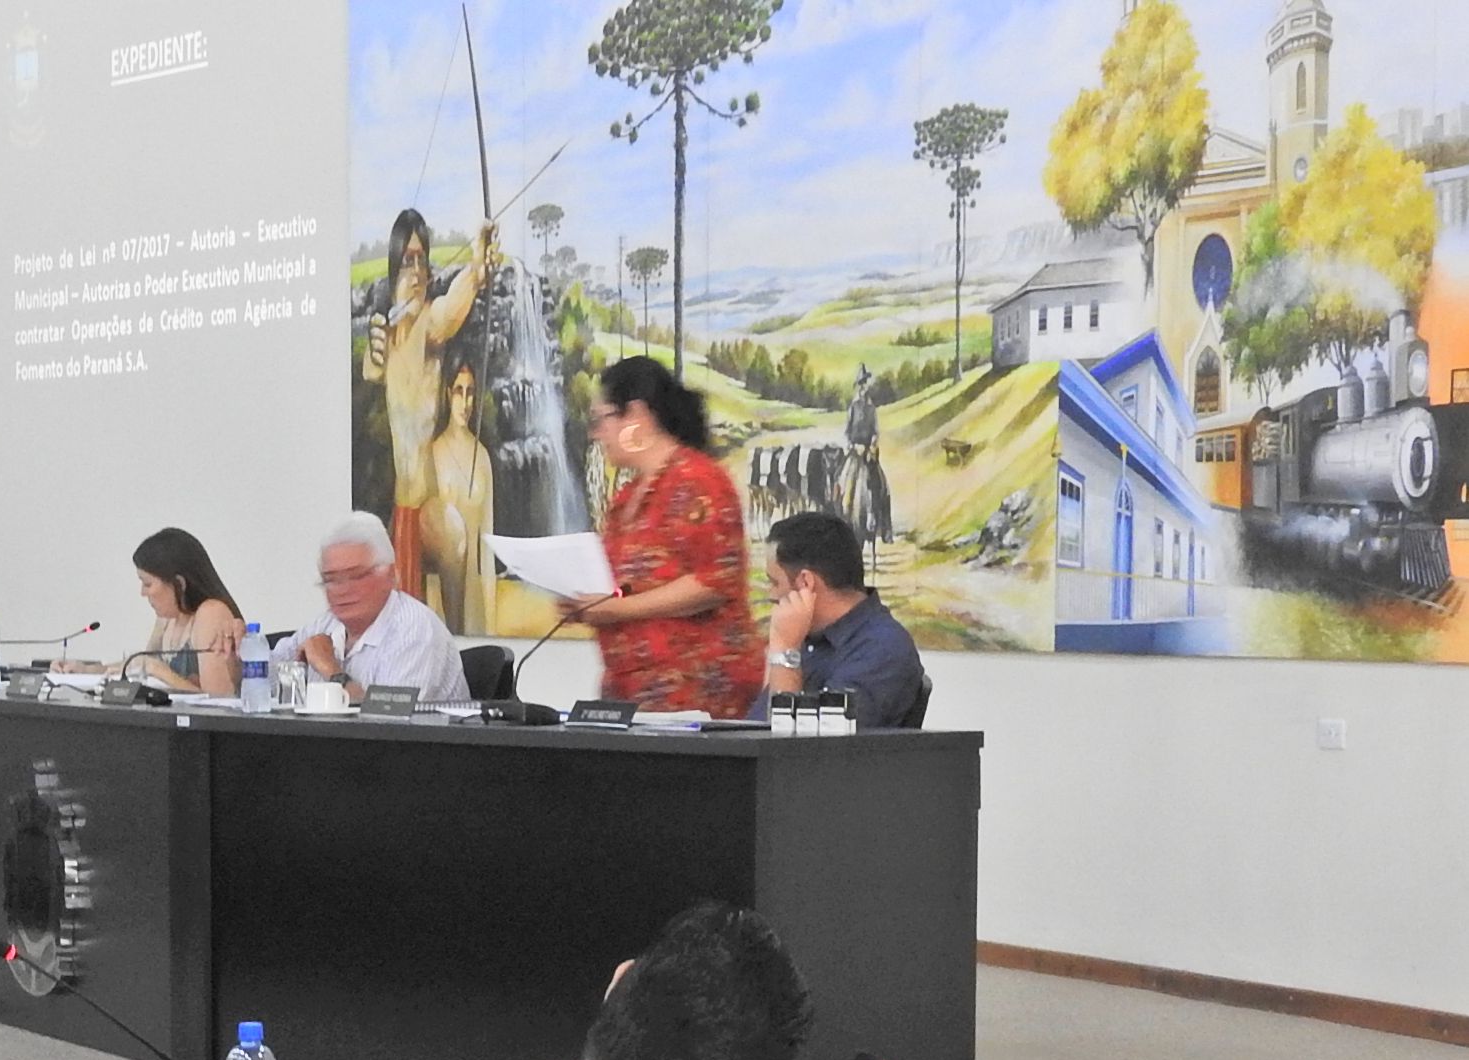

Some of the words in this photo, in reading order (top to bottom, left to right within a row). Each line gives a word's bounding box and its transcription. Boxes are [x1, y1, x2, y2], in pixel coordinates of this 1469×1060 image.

[111, 31, 208, 77] EXPEDIENTE:
[14, 254, 54, 278] Projeto
[59, 247, 74, 270] de
[80, 244, 96, 267] Lei
[102, 241, 116, 264] nº
[121, 233, 171, 264] 07/2017
[190, 225, 236, 252] Autoria
[258, 214, 317, 243] Executivo
[14, 283, 69, 312] Municipal
[82, 279, 131, 304] Autoriza
[134, 281, 142, 298] o
[144, 272, 179, 296] Poder
[182, 265, 240, 293] Executivo
[244, 253, 306, 284] Municipal
[309, 258, 317, 276] a
[15, 324, 66, 346] contratar
[71, 314, 133, 344] Operações
[138, 311, 154, 334] de
[160, 307, 204, 332] Crédito
[211, 307, 237, 326] com
[244, 296, 293, 328] Agência
[300, 291, 317, 316] de
[15, 360, 64, 381] Fomento
[66, 355, 81, 378] do
[83, 351, 123, 376] Paraná
[125, 349, 149, 372] S.A.
